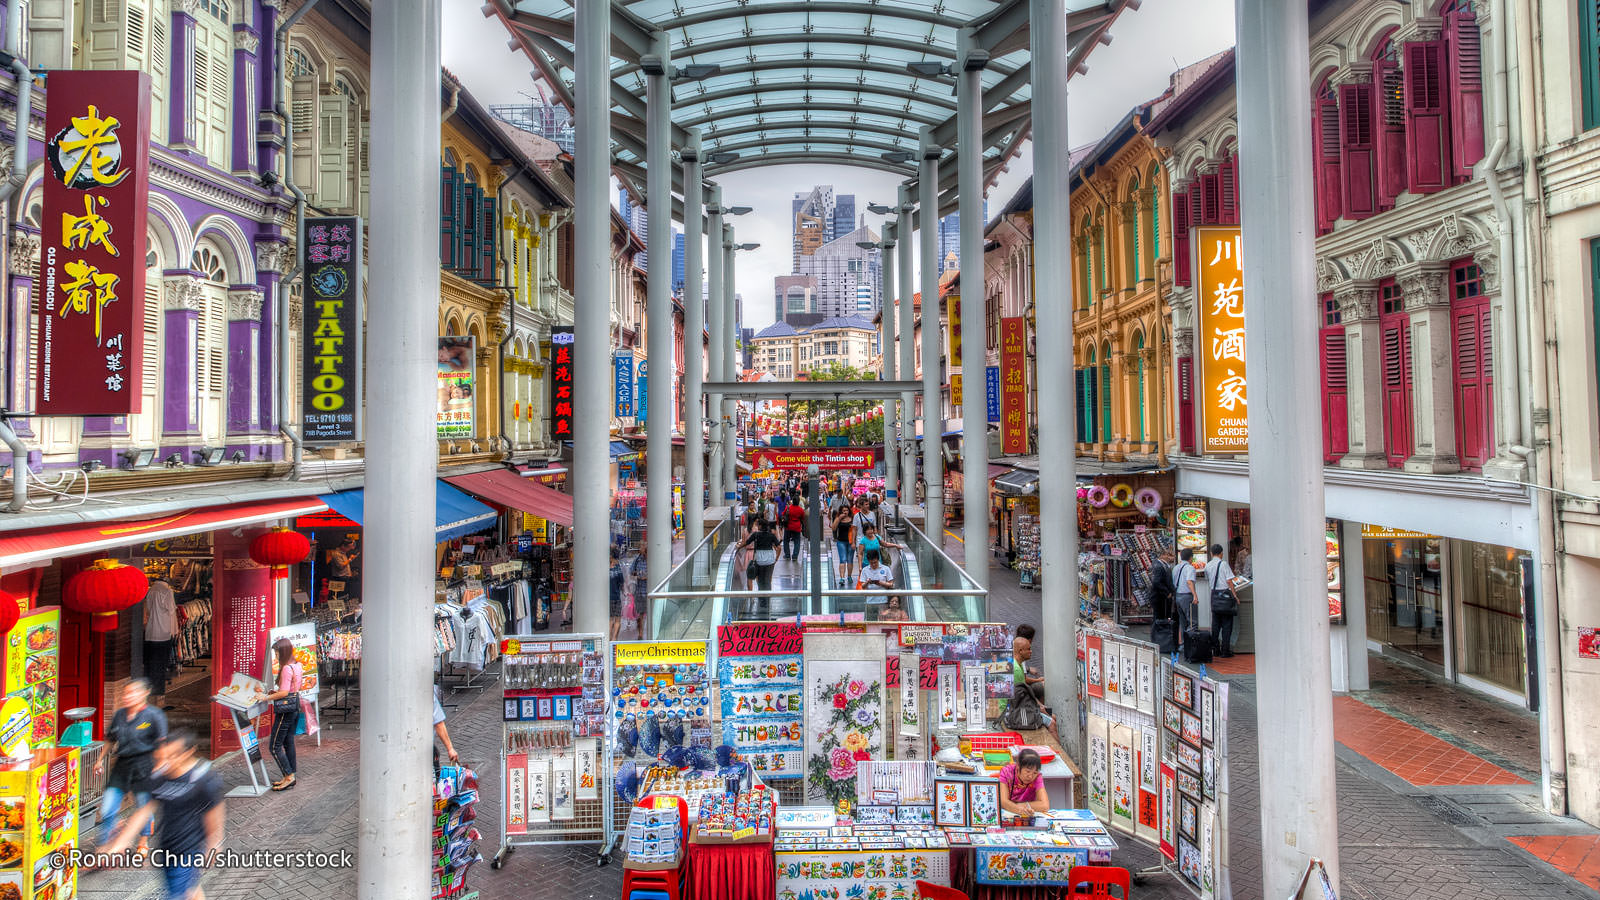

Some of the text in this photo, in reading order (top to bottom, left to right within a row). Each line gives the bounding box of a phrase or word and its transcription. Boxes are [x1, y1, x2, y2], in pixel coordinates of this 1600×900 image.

[58, 105, 130, 346] 老成都
[46, 246, 56, 310] OLD CHENGDU
[1209, 235, 1248, 411] 川苑酒家
[1005, 332, 1021, 345] 小
[312, 300, 345, 411] TATTOO
[618, 358, 630, 402] MASSAGE
[305, 414, 320, 423] TEL:
[320, 414, 336, 423] 9710
[1209, 437, 1249, 446] RESTAURA
[776, 454, 865, 464] Come visit the Tintin shop
[720, 624, 779, 641] Name
[617, 645, 706, 660] Merry Christmas
[720, 637, 803, 656] Painting
[734, 662, 798, 679] WELCOME
[736, 692, 800, 713] ALICE
[737, 722, 801, 742] THOMAS
